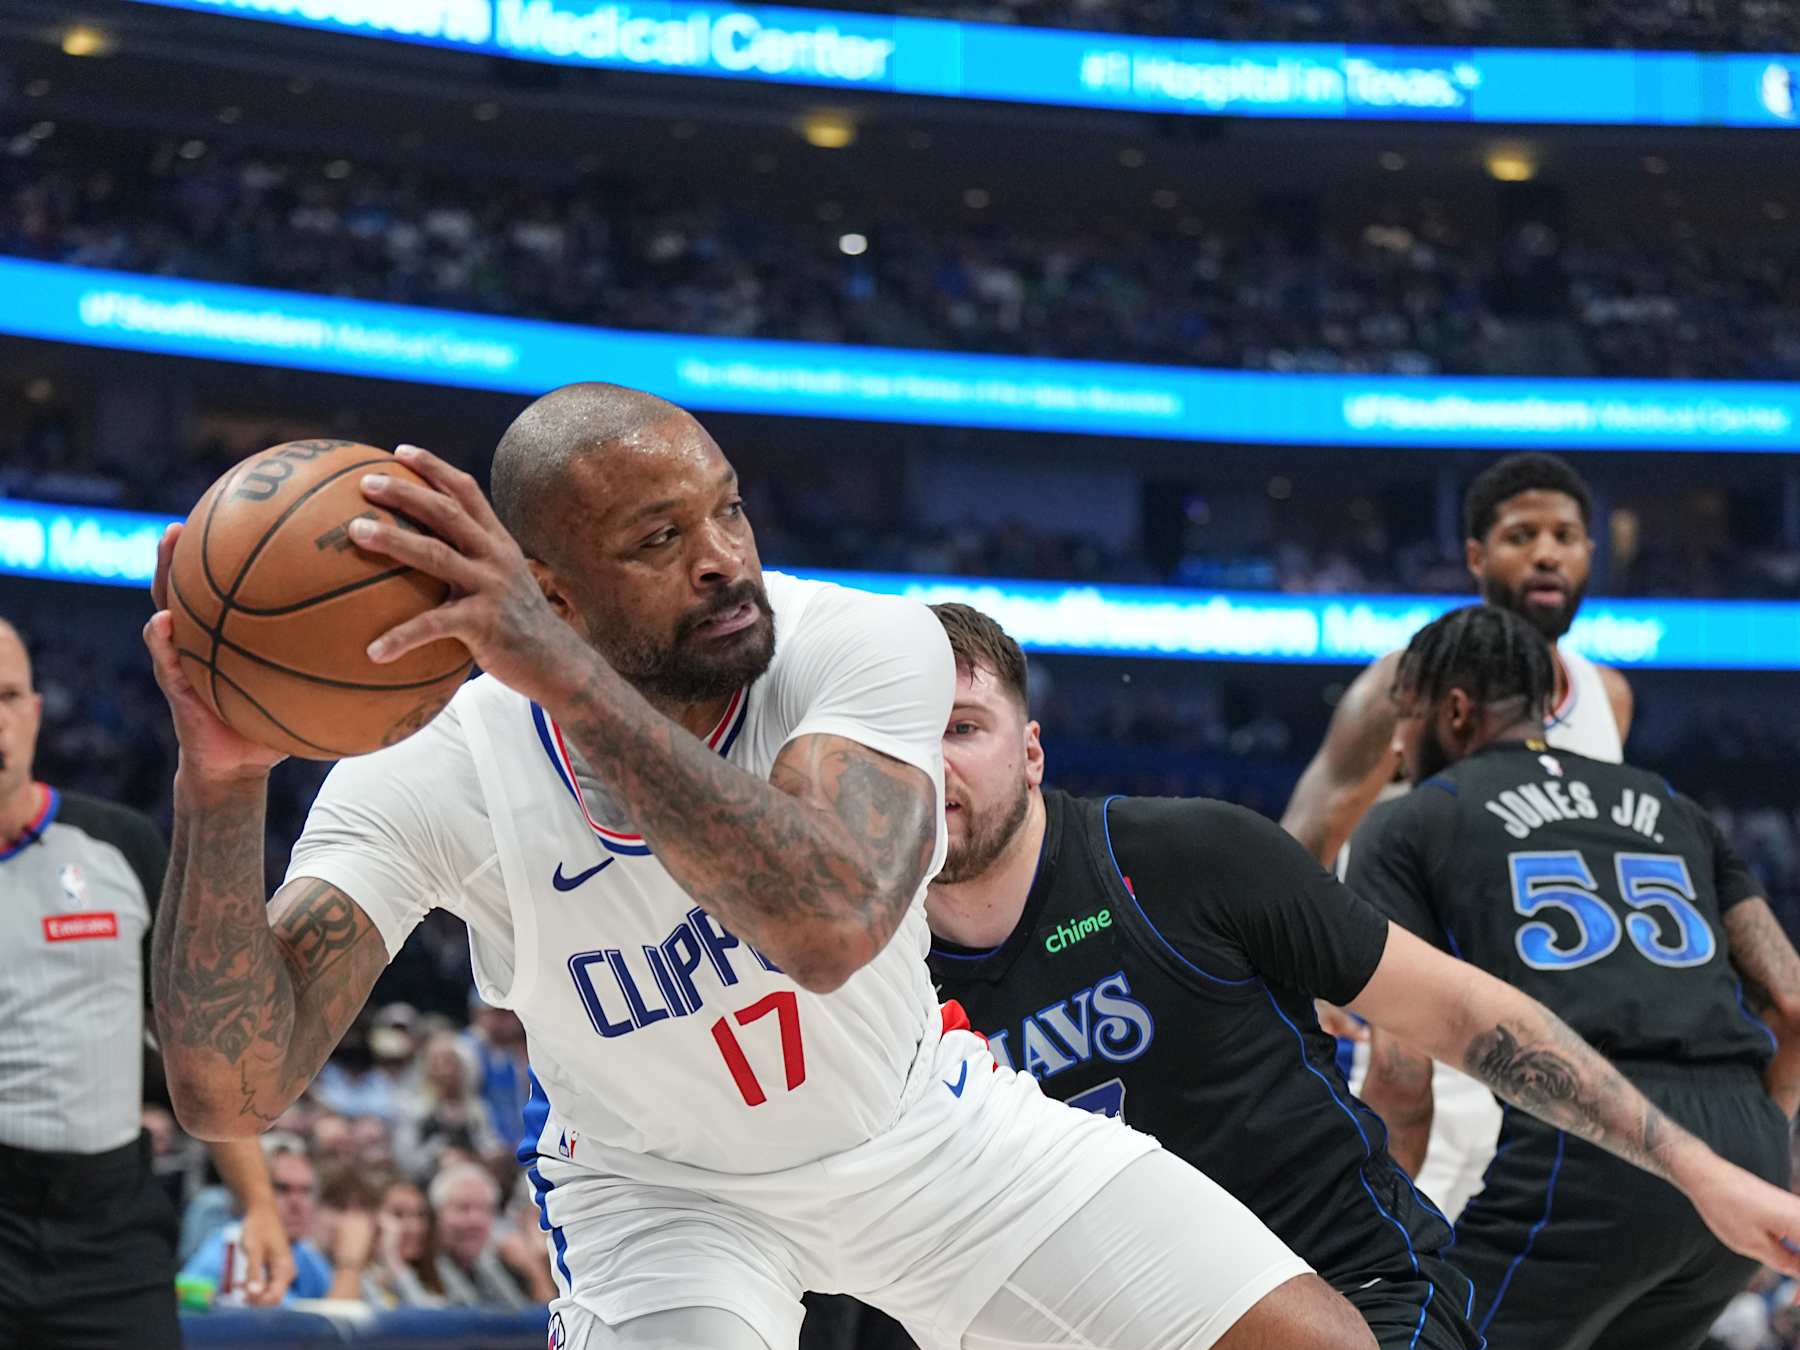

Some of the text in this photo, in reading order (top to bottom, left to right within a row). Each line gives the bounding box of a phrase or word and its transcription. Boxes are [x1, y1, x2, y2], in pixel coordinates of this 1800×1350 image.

[496, 0, 709, 66] Medical
[711, 13, 896, 80] Center
[1132, 54, 1292, 110] Hospital
[1485, 781, 1664, 843] JONES JR.
[1045, 908, 1113, 953] chime
[1508, 850, 1716, 970] 55
[567, 905, 785, 1039] CLIPP
[711, 991, 806, 1107] 17
